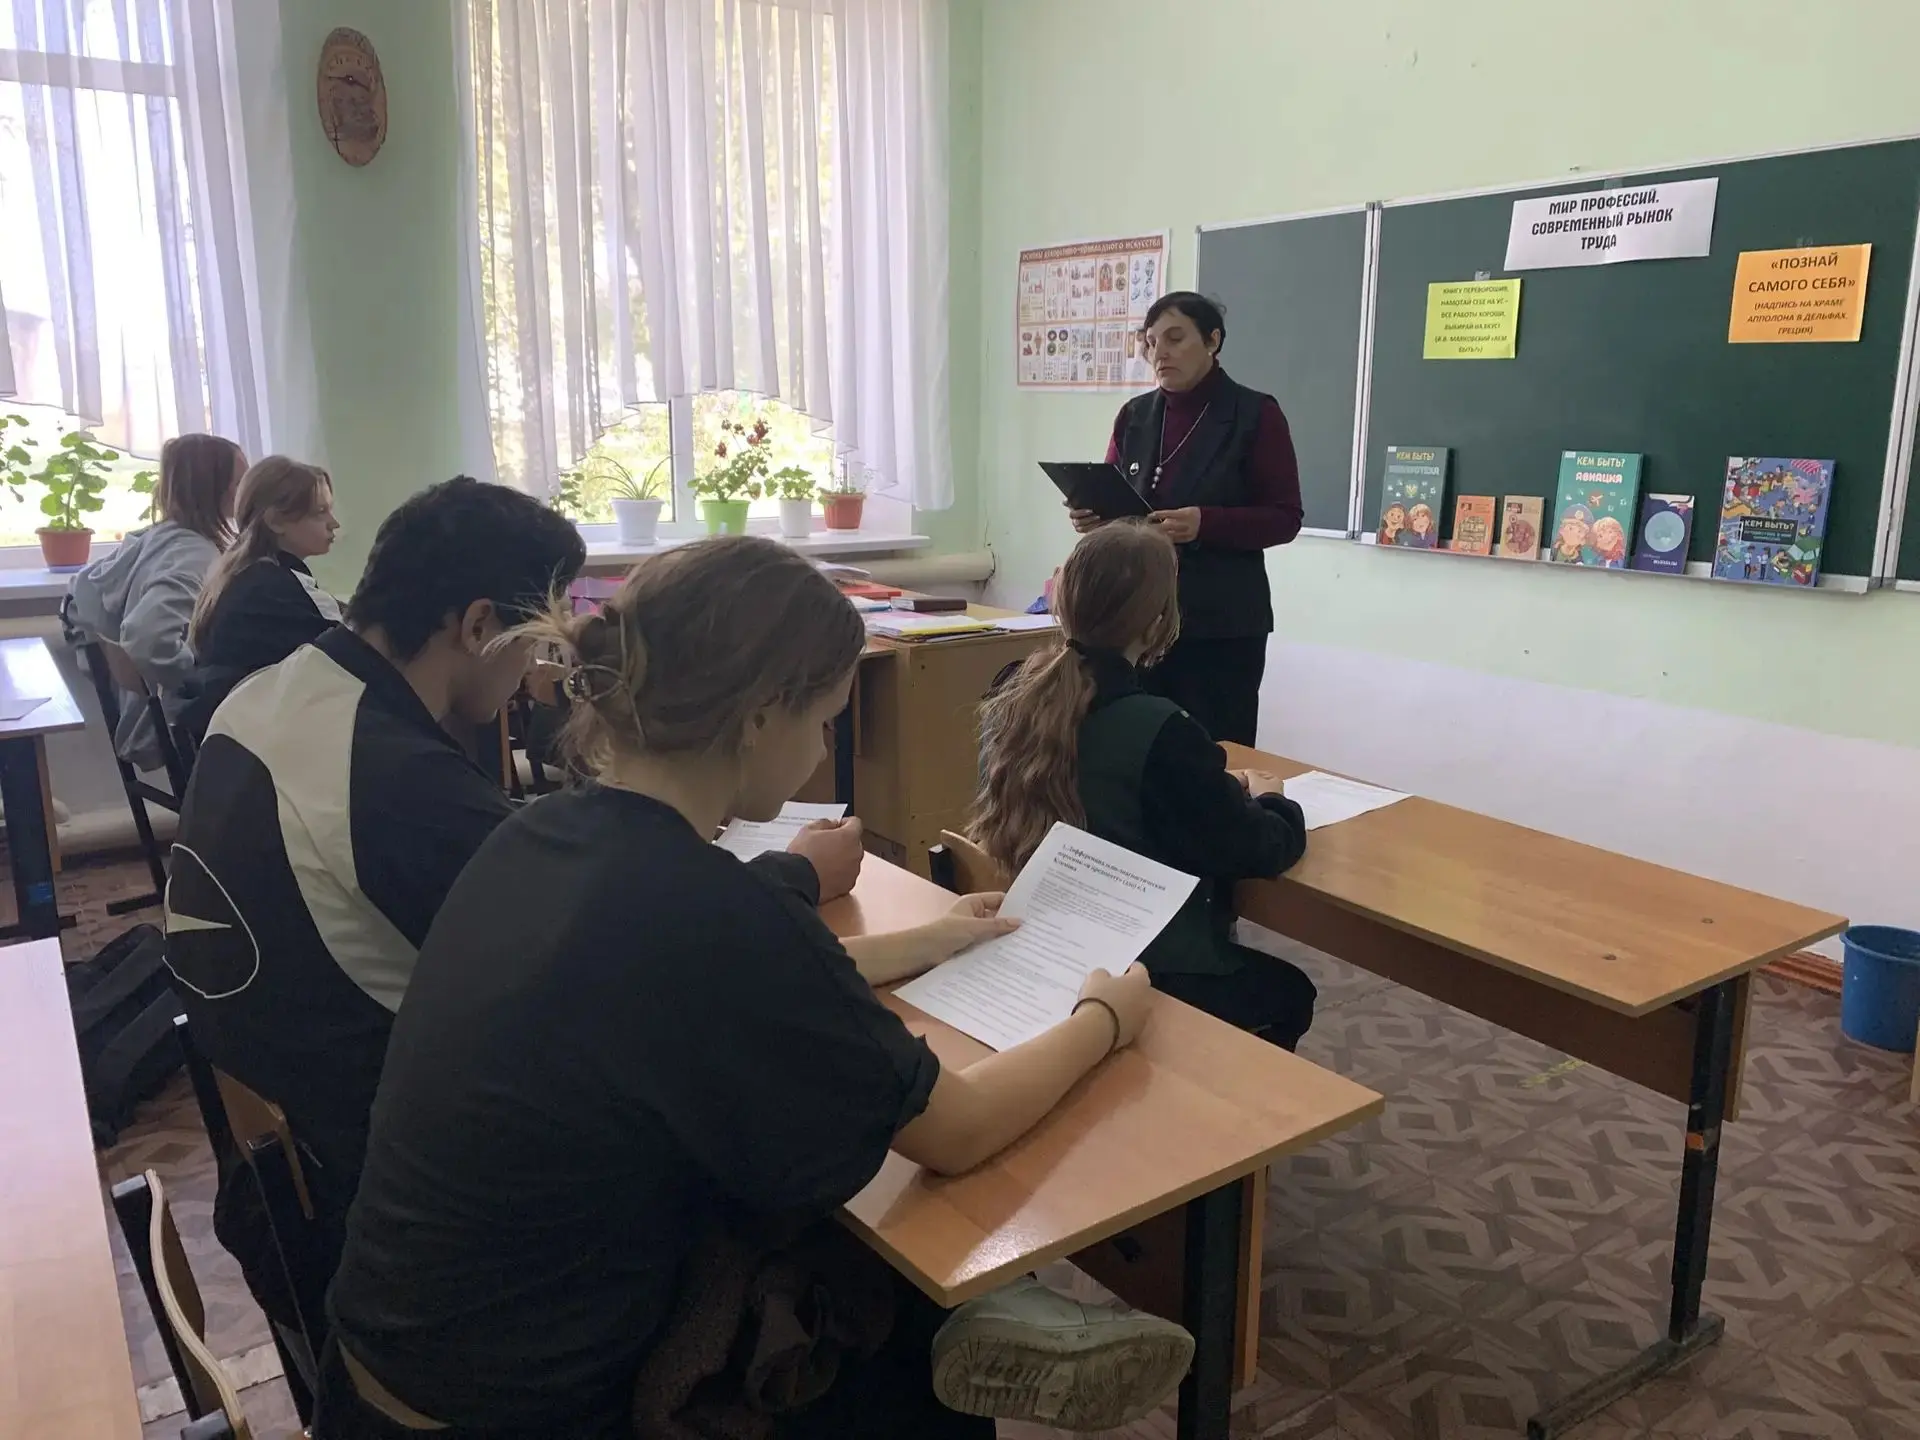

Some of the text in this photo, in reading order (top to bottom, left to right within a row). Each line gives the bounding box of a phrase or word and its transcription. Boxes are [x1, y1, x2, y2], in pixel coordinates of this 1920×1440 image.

[1549, 189, 1660, 215] МИР ПРОФЕССИЙ.
[1532, 208, 1673, 235] СОВРЕМЕННЫЙ РЫНОК
[1581, 234, 1617, 250] ТРУДА
[1771, 252, 1839, 269] «ПОЗНАЙ
[1748, 277, 1856, 293] САМОГО СЕБЯ»
[1754, 298, 1845, 310] (НАДПИСЬ НА ХРАМЕ
[1747, 314, 1795, 323] АППОЛОНА
[1777, 327, 1813, 336] ГРЕЦИЯ)
[1576, 456, 1626, 468] КЕМ БЫТЬ?
[1575, 472, 1623, 484] АВИАЦИЯ
[1744, 519, 1795, 531] КЕМ БЫТЬ?
